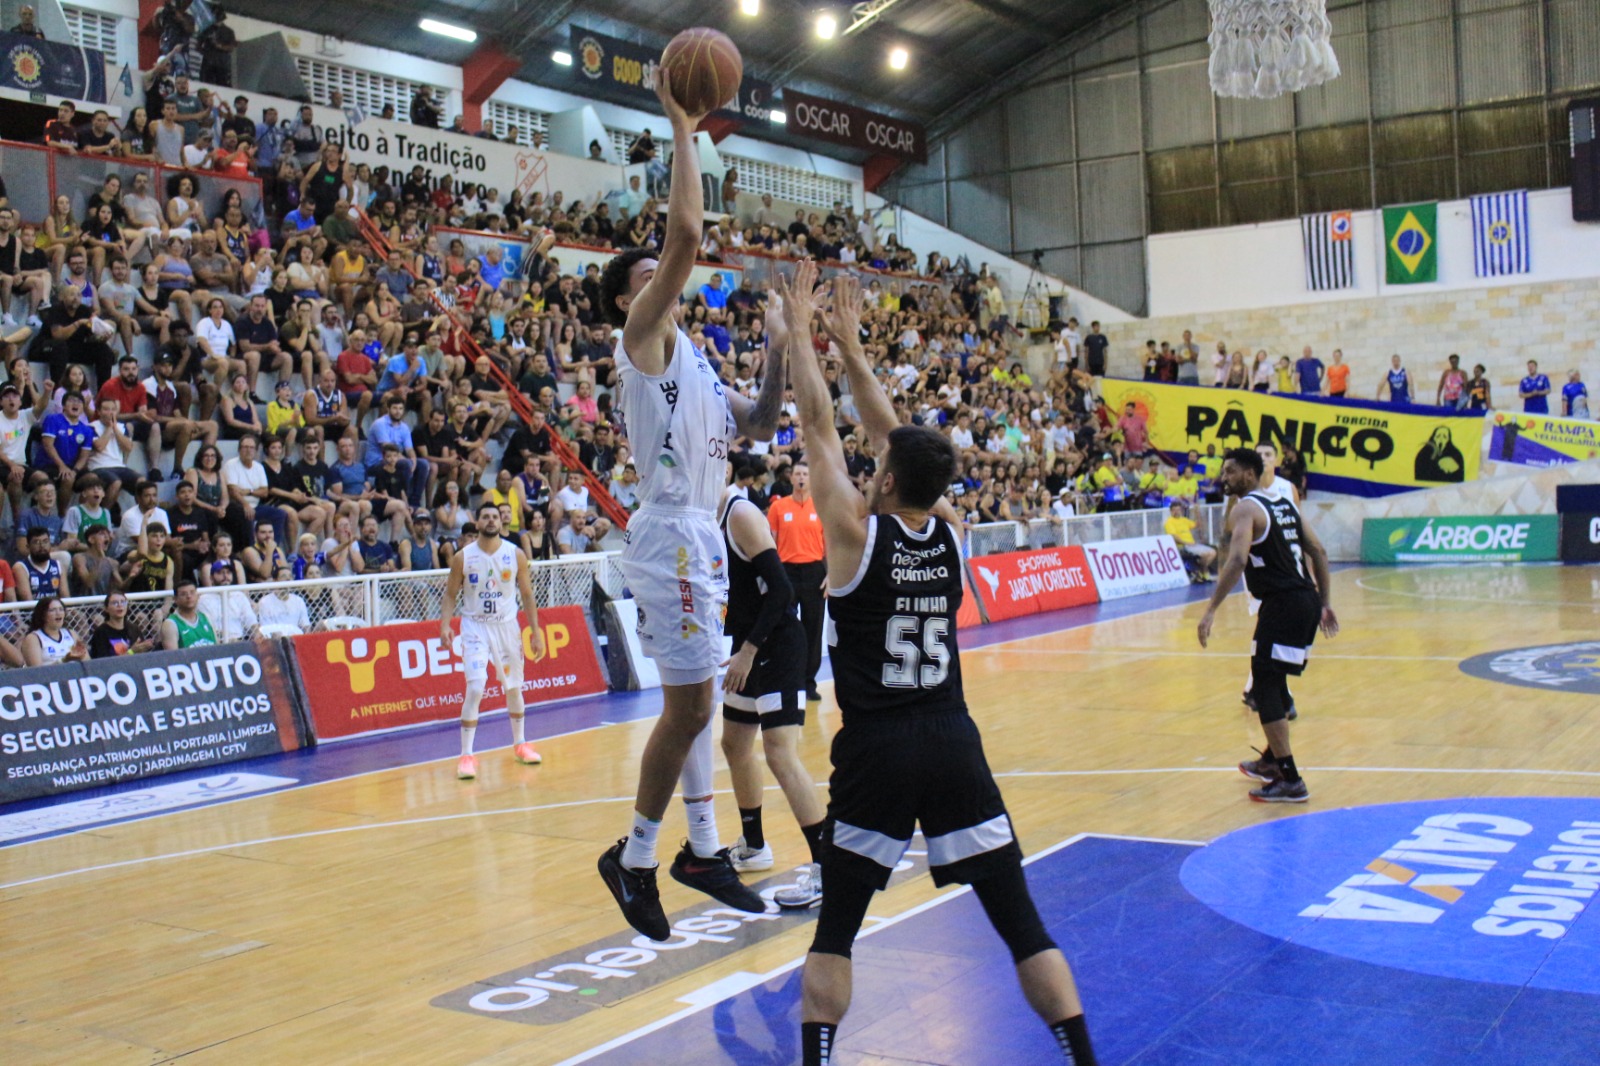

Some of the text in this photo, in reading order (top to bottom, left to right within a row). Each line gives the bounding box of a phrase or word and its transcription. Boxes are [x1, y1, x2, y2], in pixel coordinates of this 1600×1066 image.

[613, 55, 641, 86] COOP
[795, 102, 914, 153] OSCAR OSCAR
[376, 128, 389, 155] à
[395, 133, 486, 174] Tradição
[1185, 400, 1394, 470] PÂNICO
[1336, 414, 1388, 429] TORCIDA
[1544, 422, 1594, 438] RAMPA
[1412, 518, 1530, 550] ÁRBORE
[891, 566, 949, 585] química
[892, 552, 921, 566] neo
[1017, 552, 1062, 573] SHOPPING
[1087, 539, 1181, 580] Tomovale
[478, 591, 503, 599] COOP
[1008, 573, 1046, 601] JARDIM
[1043, 567, 1087, 592] ORIENTE
[483, 600, 497, 614] 91
[397, 622, 570, 680] DESOP
[882, 614, 951, 689] 55
[0, 654, 262, 721] GRUPO BRUTO
[350, 708, 360, 719] A
[360, 699, 413, 718] INTERNET
[415, 695, 437, 709] QUE
[439, 692, 464, 706] MAIS
[521, 678, 552, 692] STADO
[552, 676, 566, 687] DE
[565, 674, 577, 685] SP
[1, 693, 271, 755] SEGURANÇA E SERVIÇOS
[7, 757, 87, 778] SEGURANÇA
[89, 743, 166, 767] PATRIMONIAL
[173, 731, 226, 751] PORTARIA
[232, 722, 276, 740] LIMPEZA
[53, 763, 137, 787] MANUTENÇÃO
[145, 749, 214, 772] JARDINAGEM
[222, 742, 247, 756] CFTV
[1297, 812, 1534, 925] CAIXA
